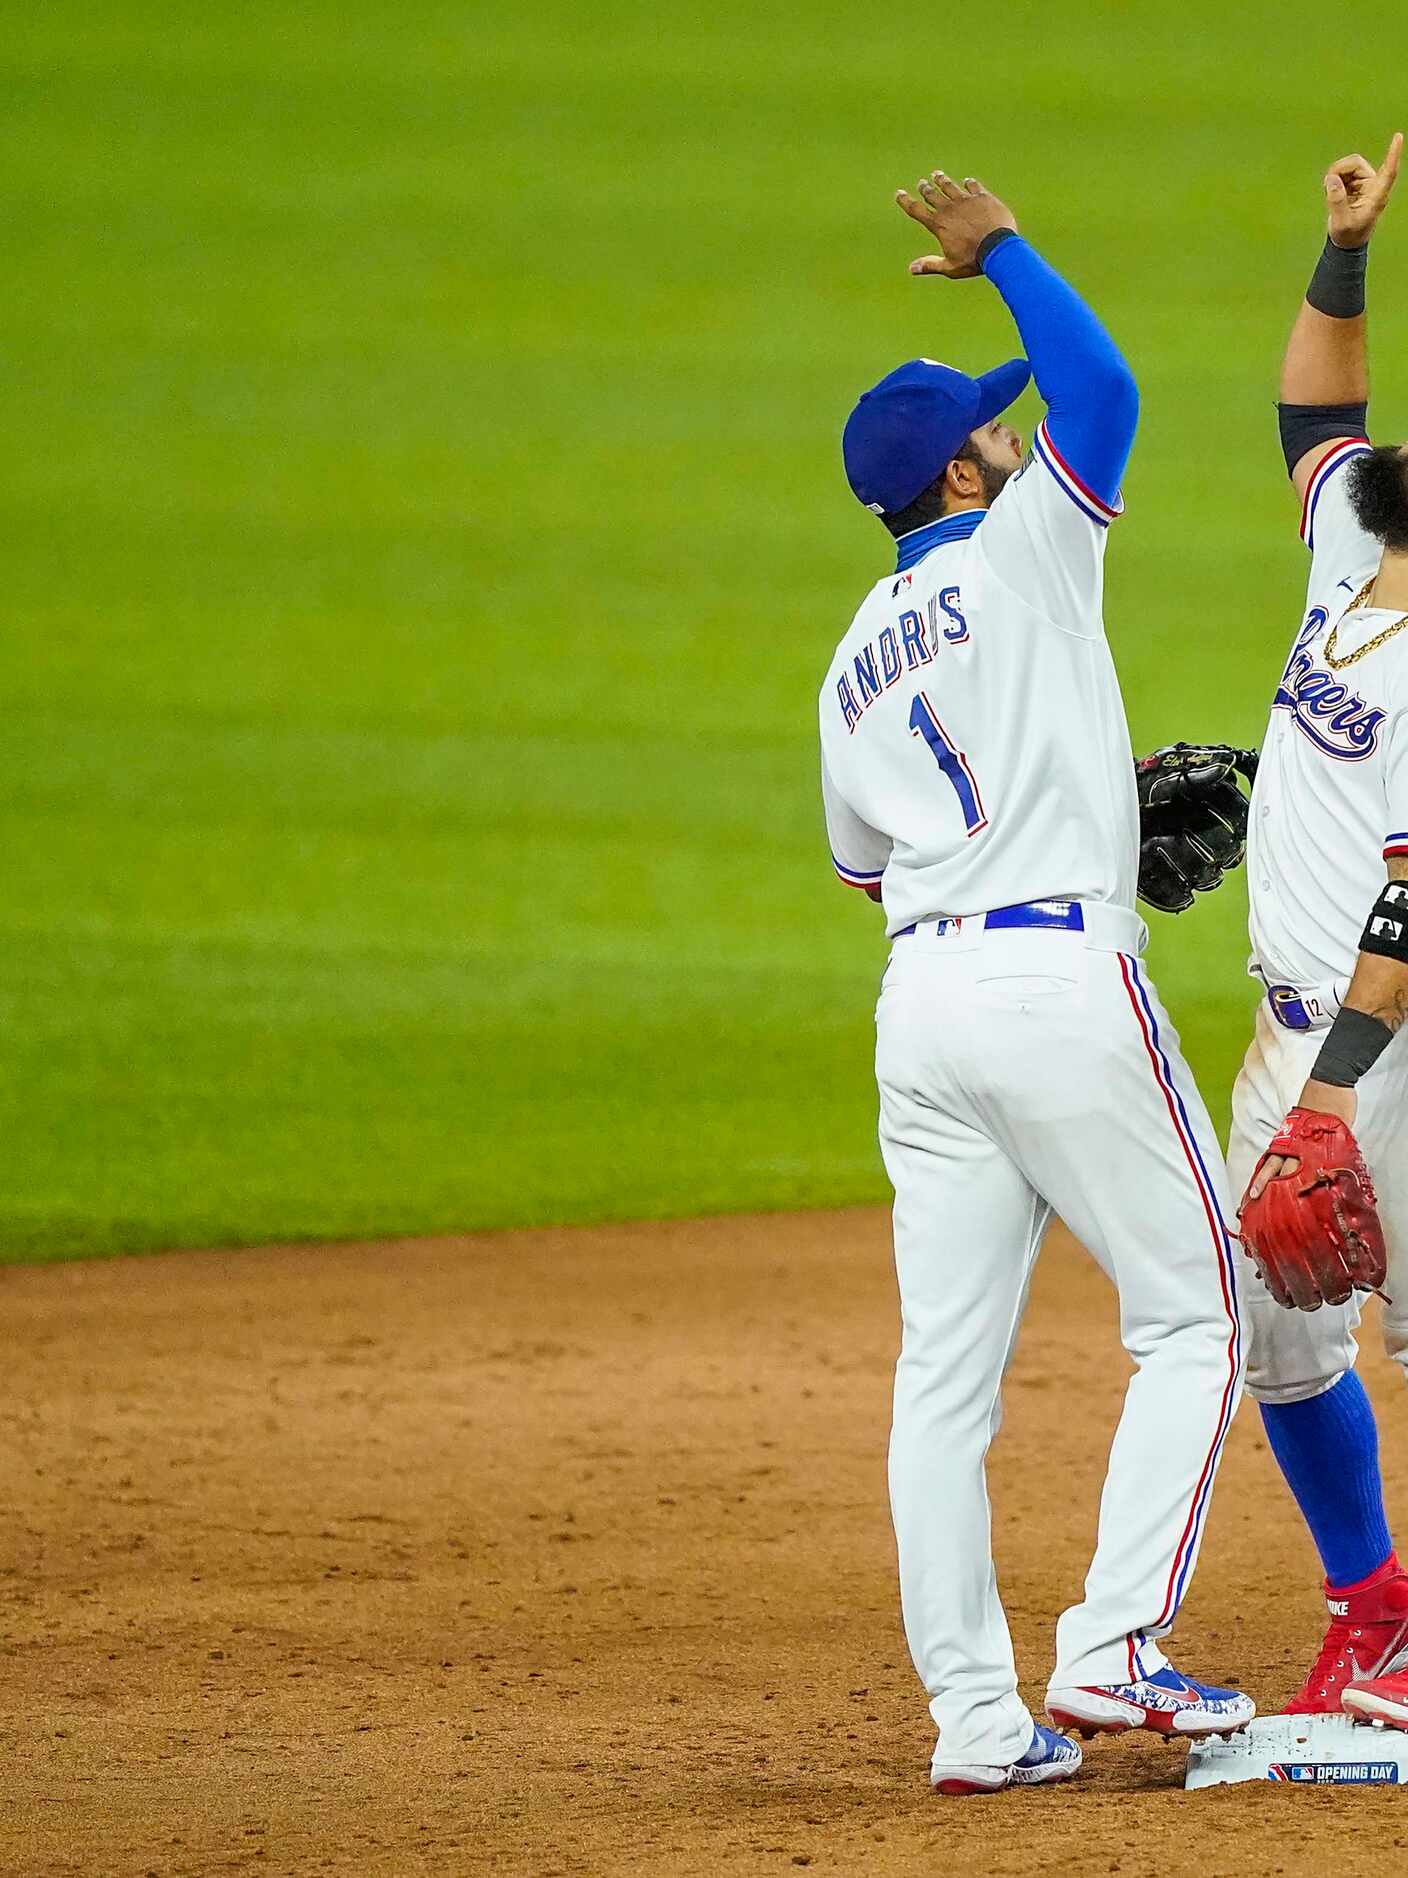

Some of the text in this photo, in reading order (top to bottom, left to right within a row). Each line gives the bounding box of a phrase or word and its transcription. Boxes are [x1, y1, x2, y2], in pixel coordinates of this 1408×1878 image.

[836, 585, 970, 735] ANDRS
[908, 691, 988, 838] 1
[1305, 998, 1323, 1017] 12
[1327, 1599, 1349, 1616] NIKE
[1316, 1766, 1394, 1780] OPENING DAY
